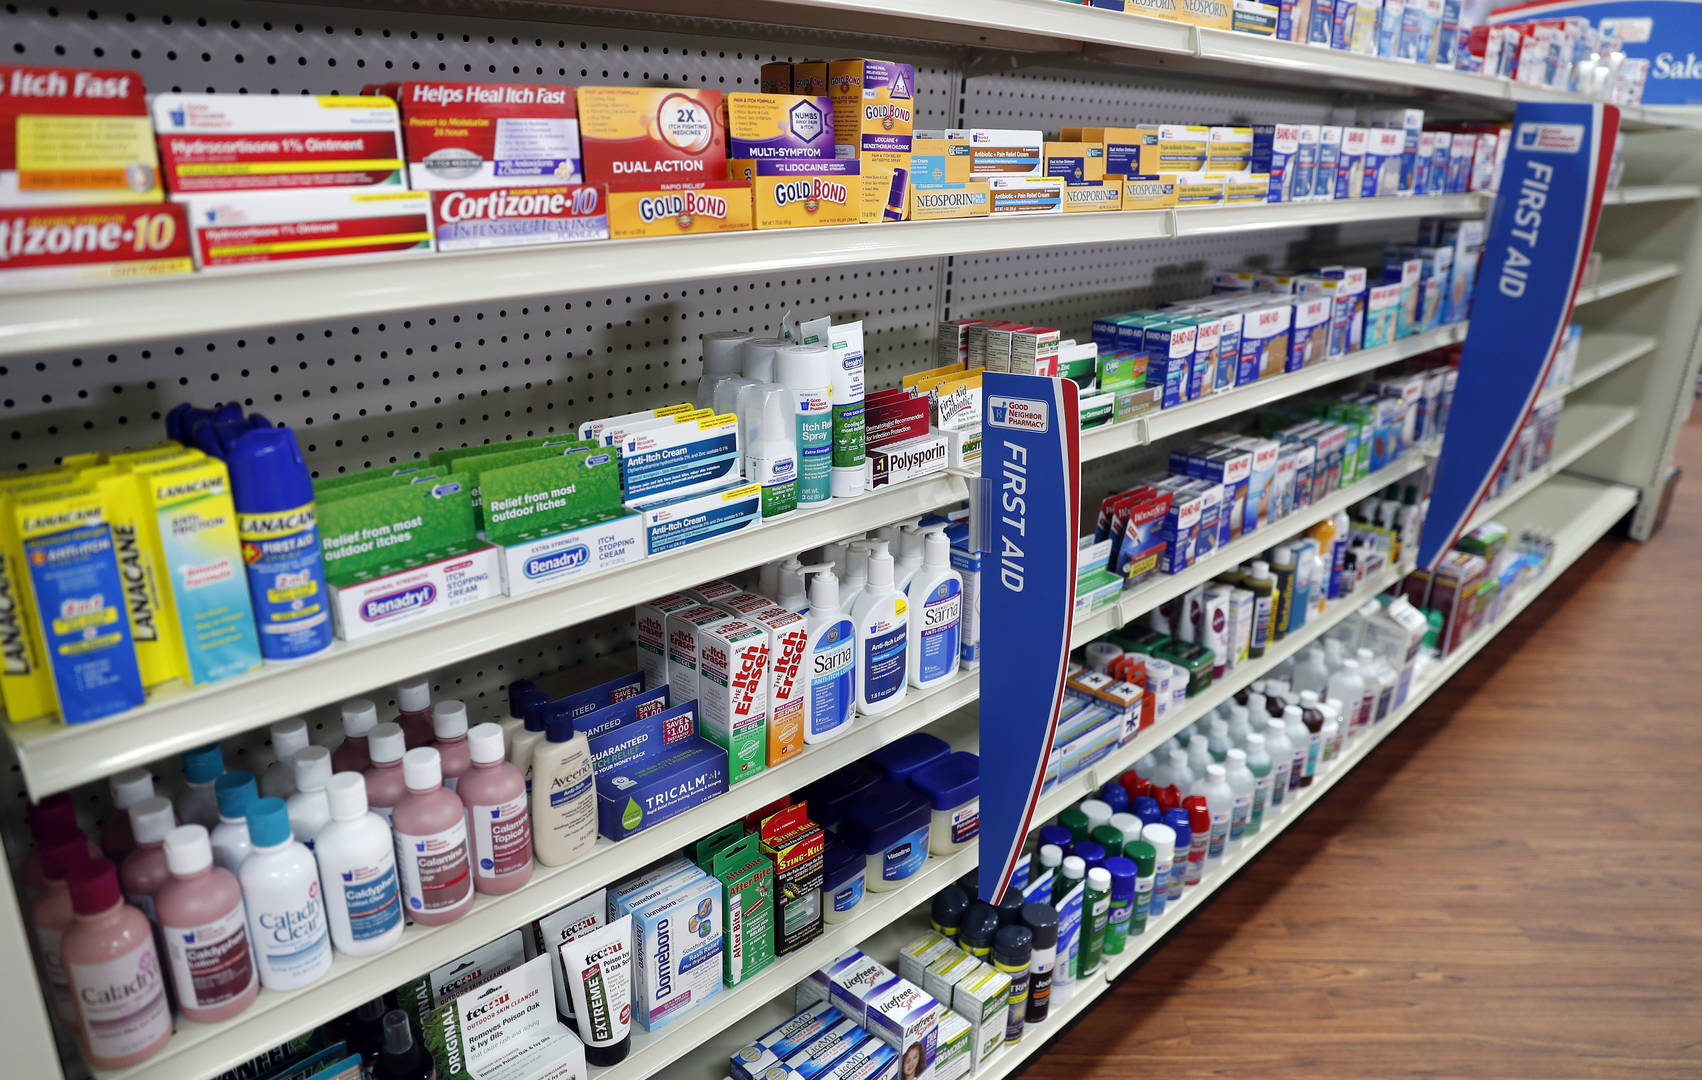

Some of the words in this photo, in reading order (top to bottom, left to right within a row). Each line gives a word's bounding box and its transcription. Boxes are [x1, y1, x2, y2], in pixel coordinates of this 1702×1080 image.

[11, 71, 67, 98] Itch
[74, 73, 130, 98] Fast
[413, 85, 463, 106] Helps
[465, 87, 505, 104] Heal
[506, 88, 533, 103] Itch
[536, 90, 566, 104] Fast
[677, 109, 696, 123] 2X
[795, 112, 818, 120] NUMBS
[866, 105, 887, 120] GOLD
[889, 104, 910, 122] BOND
[171, 140, 279, 157] Hydrocortisone
[282, 139, 303, 153] 1%
[305, 139, 364, 152] Ointment
[749, 147, 821, 157] MULTI-SYMPTOM
[612, 161, 652, 174] DUAL
[654, 160, 704, 173] ACTION
[785, 163, 828, 172] LIDOCAINE
[776, 180, 811, 205] GOLD
[813, 178, 847, 204] BOND
[917, 194, 973, 207] NEOSPORIN
[1067, 190, 1108, 203] NEOSPORIN
[1127, 184, 1164, 195] NEOSPORIN
[641, 195, 682, 222] GOLD
[685, 190, 728, 218] BOND
[1512, 160, 1554, 248] FIRST
[453, 220, 533, 239] INTENSIVE
[541, 217, 598, 232] HEALING
[558, 230, 600, 241] FORMULA
[1500, 246, 1532, 298] AID
[1118, 328, 1143, 337] BAND-AID
[1146, 331, 1170, 340] BAND-AID
[1171, 329, 1196, 346] BAND-AID
[1199, 323, 1220, 338] BAND-AID
[940, 397, 955, 415] First
[955, 385, 968, 398] Aid
[1009, 401, 1029, 411] GOOD
[866, 419, 895, 433] Dermatologist
[895, 413, 924, 424] Recommended
[1008, 409, 1042, 420] NEIGHBOR
[1008, 417, 1045, 430] PHARMACY
[802, 431, 827, 442] Spray
[872, 430, 891, 441] Infection
[891, 425, 911, 437] Protection
[628, 452, 661, 468] Anti-Itch
[662, 447, 688, 458] Cream
[890, 443, 945, 472] Polysporin
[157, 477, 224, 500] LANACANE
[491, 495, 522, 512] Relief
[524, 490, 549, 503] from
[550, 484, 576, 498] most
[1003, 440, 1027, 537] FIRST
[23, 507, 102, 532] LANACANE
[492, 505, 535, 523] outdoor
[536, 498, 566, 511] itches
[323, 531, 361, 550] Relief
[362, 524, 391, 539] from
[393, 516, 422, 532] most
[652, 521, 682, 536] Anti-Itch
[684, 515, 707, 527] Cream
[263, 538, 291, 553] FIRST
[292, 535, 315, 548] AID
[325, 542, 375, 562] outdoor
[376, 532, 411, 547] itches
[531, 543, 551, 553] EXTRA
[551, 537, 579, 549] STRENGTH
[598, 535, 615, 544] ITCH
[599, 537, 635, 552] STOPPING
[530, 550, 584, 575] Benadryl
[599, 547, 626, 561] CREAM
[1001, 536, 1025, 593] AID
[114, 524, 158, 641] LANACANE
[368, 588, 430, 617] Benadryl
[925, 602, 959, 626] Sarna
[702, 649, 728, 669] Eraser
[711, 646, 726, 662] Itch
[774, 631, 800, 673] Itch
[814, 646, 851, 673] Sarna
[732, 646, 759, 687] Itch
[776, 629, 808, 699] Eraser
[735, 642, 771, 716] Eraser
[614, 690, 632, 700] SAVE
[639, 704, 657, 713] SAVE
[666, 719, 684, 730] SAVE
[666, 724, 690, 737] $1.00
[747, 723, 758, 731] GEL
[591, 733, 649, 763] GUARANTEED
[551, 764, 592, 789] Aveeno
[646, 774, 706, 809] TRICALM
[493, 826, 524, 843] Topical
[775, 821, 816, 843] STING-KILL
[419, 849, 463, 868] Calamine
[779, 843, 824, 871] STING-KILL
[887, 847, 911, 861] Vaseline
[726, 867, 745, 882] After
[745, 858, 763, 870] Bite
[617, 879, 650, 897] Domeboro
[729, 878, 753, 897] After
[753, 867, 772, 883] Bite
[629, 889, 662, 909] Domeboro
[644, 900, 677, 918] Domeboro
[561, 914, 596, 940] tecnu
[733, 910, 741, 932] Bite
[188, 930, 246, 961] Caldyphen
[584, 941, 624, 966] tecnu
[733, 934, 741, 959] After
[603, 956, 620, 967] Poison
[620, 951, 630, 960] Ivy
[654, 918, 671, 1000] Domeboro
[439, 969, 483, 997] tecnu
[843, 965, 877, 989] Licefreee
[466, 993, 510, 1021] tecnu
[467, 1010, 495, 1031] OUTDOOR
[496, 1003, 510, 1016] SKIN
[511, 988, 540, 1008] CLEANSER
[589, 976, 608, 1040] EXTREME
[880, 987, 913, 1013] Licefreee
[469, 1024, 501, 1044] Removes
[502, 1010, 525, 1026] Poison
[526, 1001, 540, 1014] Oak
[780, 1012, 812, 1036] LiceMD
[905, 1011, 936, 1038] Licefreee
[442, 1006, 461, 1075] ORIGINAL
[470, 1045, 476, 1053] &
[477, 1039, 488, 1049] Ivy
[490, 1030, 504, 1041] Oils
[804, 1032, 838, 1057] LiceMD
[833, 1051, 865, 1078] LiceMD
